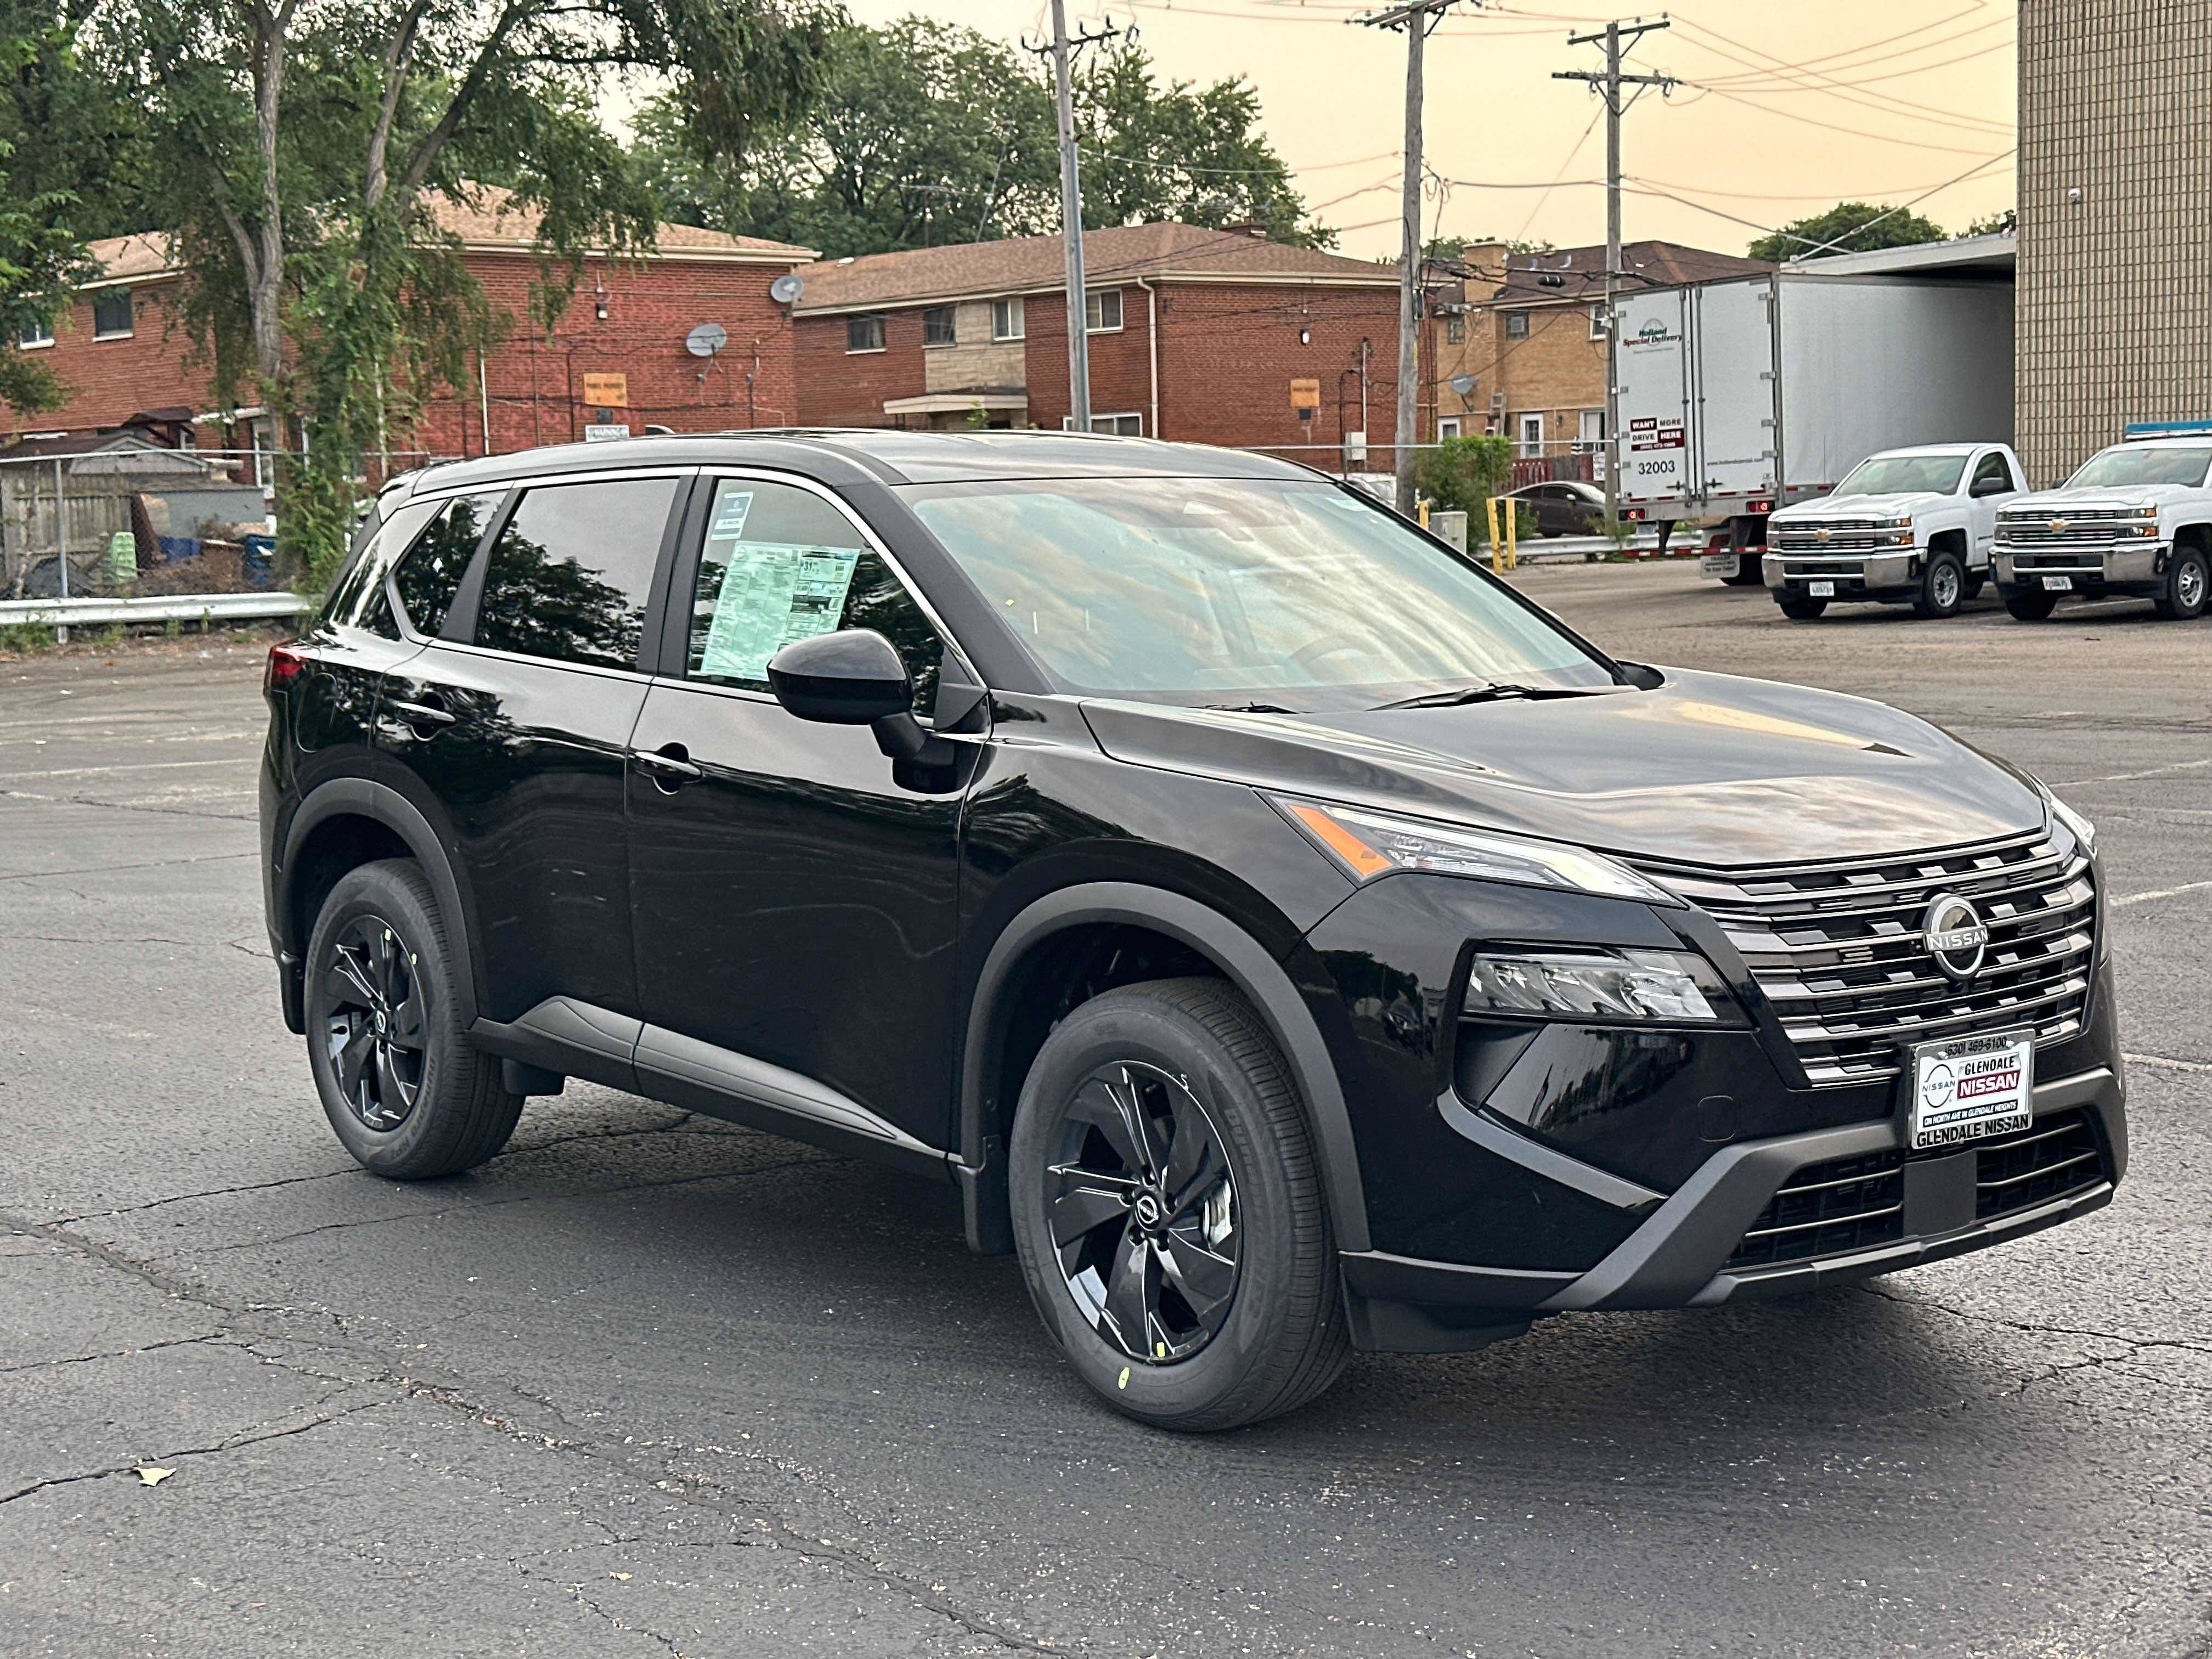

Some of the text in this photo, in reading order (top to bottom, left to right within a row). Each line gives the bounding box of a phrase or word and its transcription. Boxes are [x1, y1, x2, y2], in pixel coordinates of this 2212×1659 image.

[1639, 327, 1667, 337] Holland
[1623, 335, 1683, 347] Special Delivery
[1632, 418, 1681, 430] WANT MORE
[1632, 430, 1681, 442] DRIVE HERE
[1638, 460, 1675, 475] 32003
[1929, 930, 1989, 950] NISSAN
[1968, 1036, 2007, 1052] 469-6100
[1965, 1056, 2015, 1075] GLENDALE
[1922, 1080, 1956, 1092] NISSAN
[1960, 1072, 2018, 1097] NISSAN
[1923, 1101, 2017, 1126] ON NORTH AVE IN GLENDALE HEIGHTS
[1917, 1113, 2029, 1147] GLENDALE NISSAN
